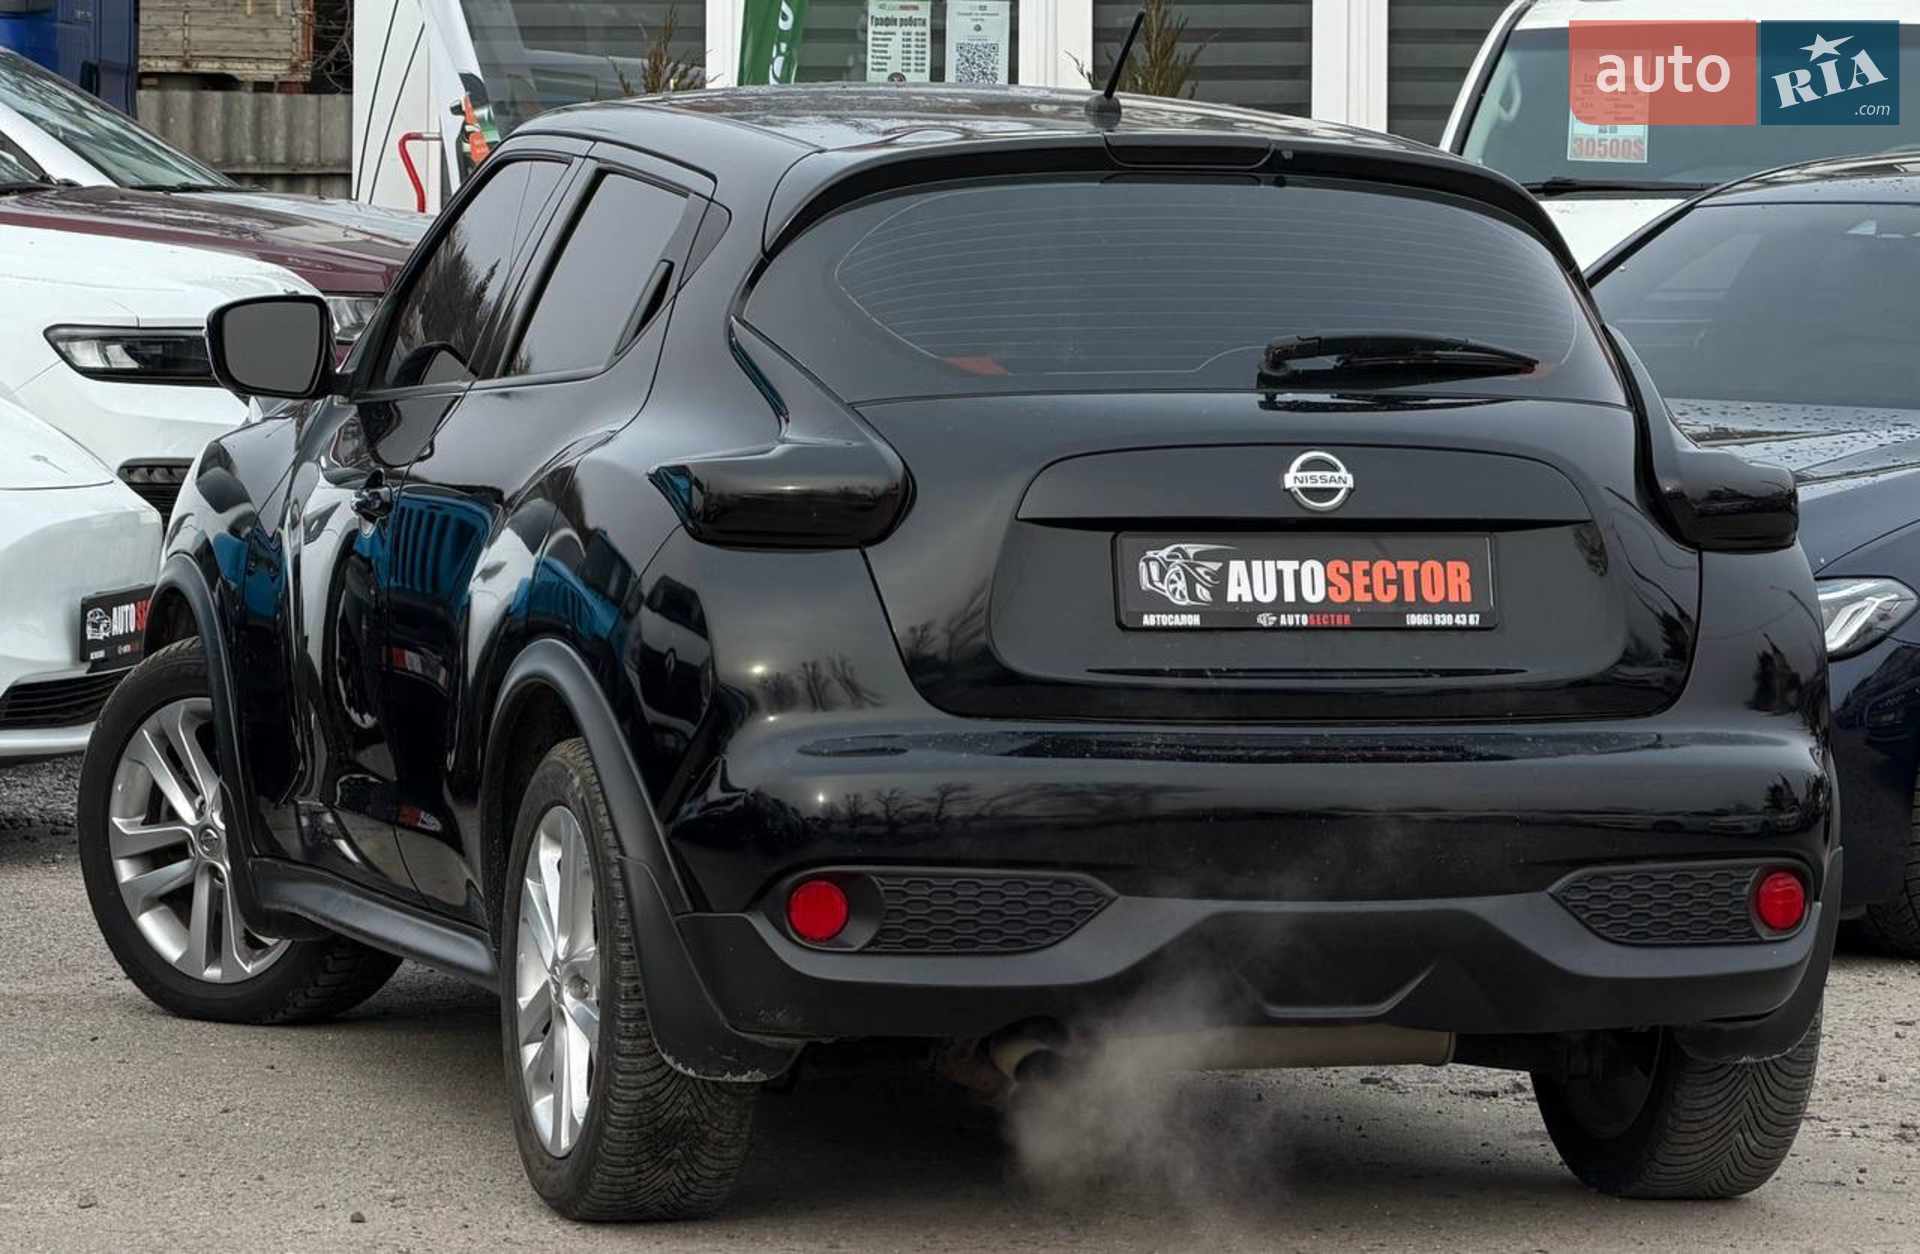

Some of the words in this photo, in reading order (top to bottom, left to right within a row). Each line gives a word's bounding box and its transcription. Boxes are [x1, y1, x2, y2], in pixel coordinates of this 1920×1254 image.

[1293, 474, 1348, 485] NISSAN
[1226, 558, 1472, 604] AUTOSECTOR
[1142, 613, 1201, 627] АВТОСАЛОН
[1279, 613, 1351, 626] AUTOSECTOR
[1454, 613, 1467, 626] 43
